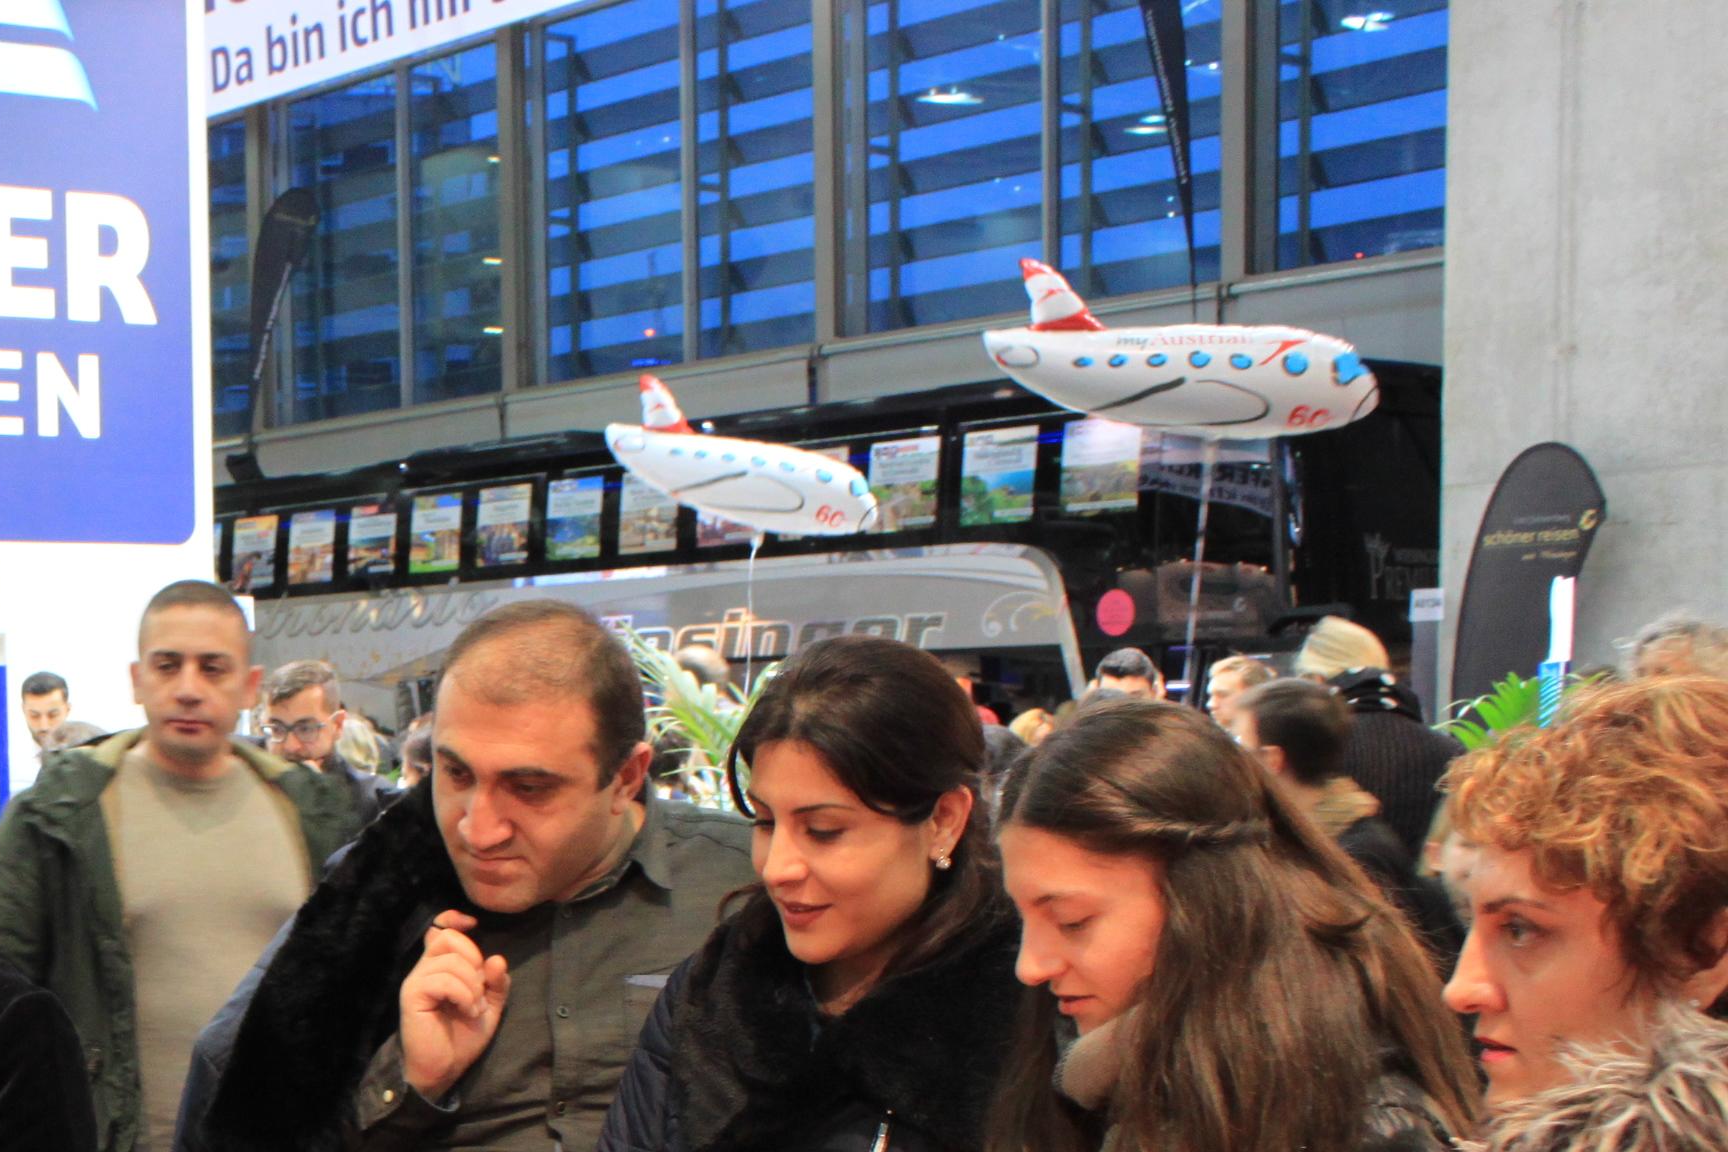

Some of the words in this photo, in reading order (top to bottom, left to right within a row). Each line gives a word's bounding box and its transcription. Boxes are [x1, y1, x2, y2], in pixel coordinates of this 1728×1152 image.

[210, 44, 255, 93] Da
[265, 13, 326, 77] bin
[338, 0, 395, 53] ich
